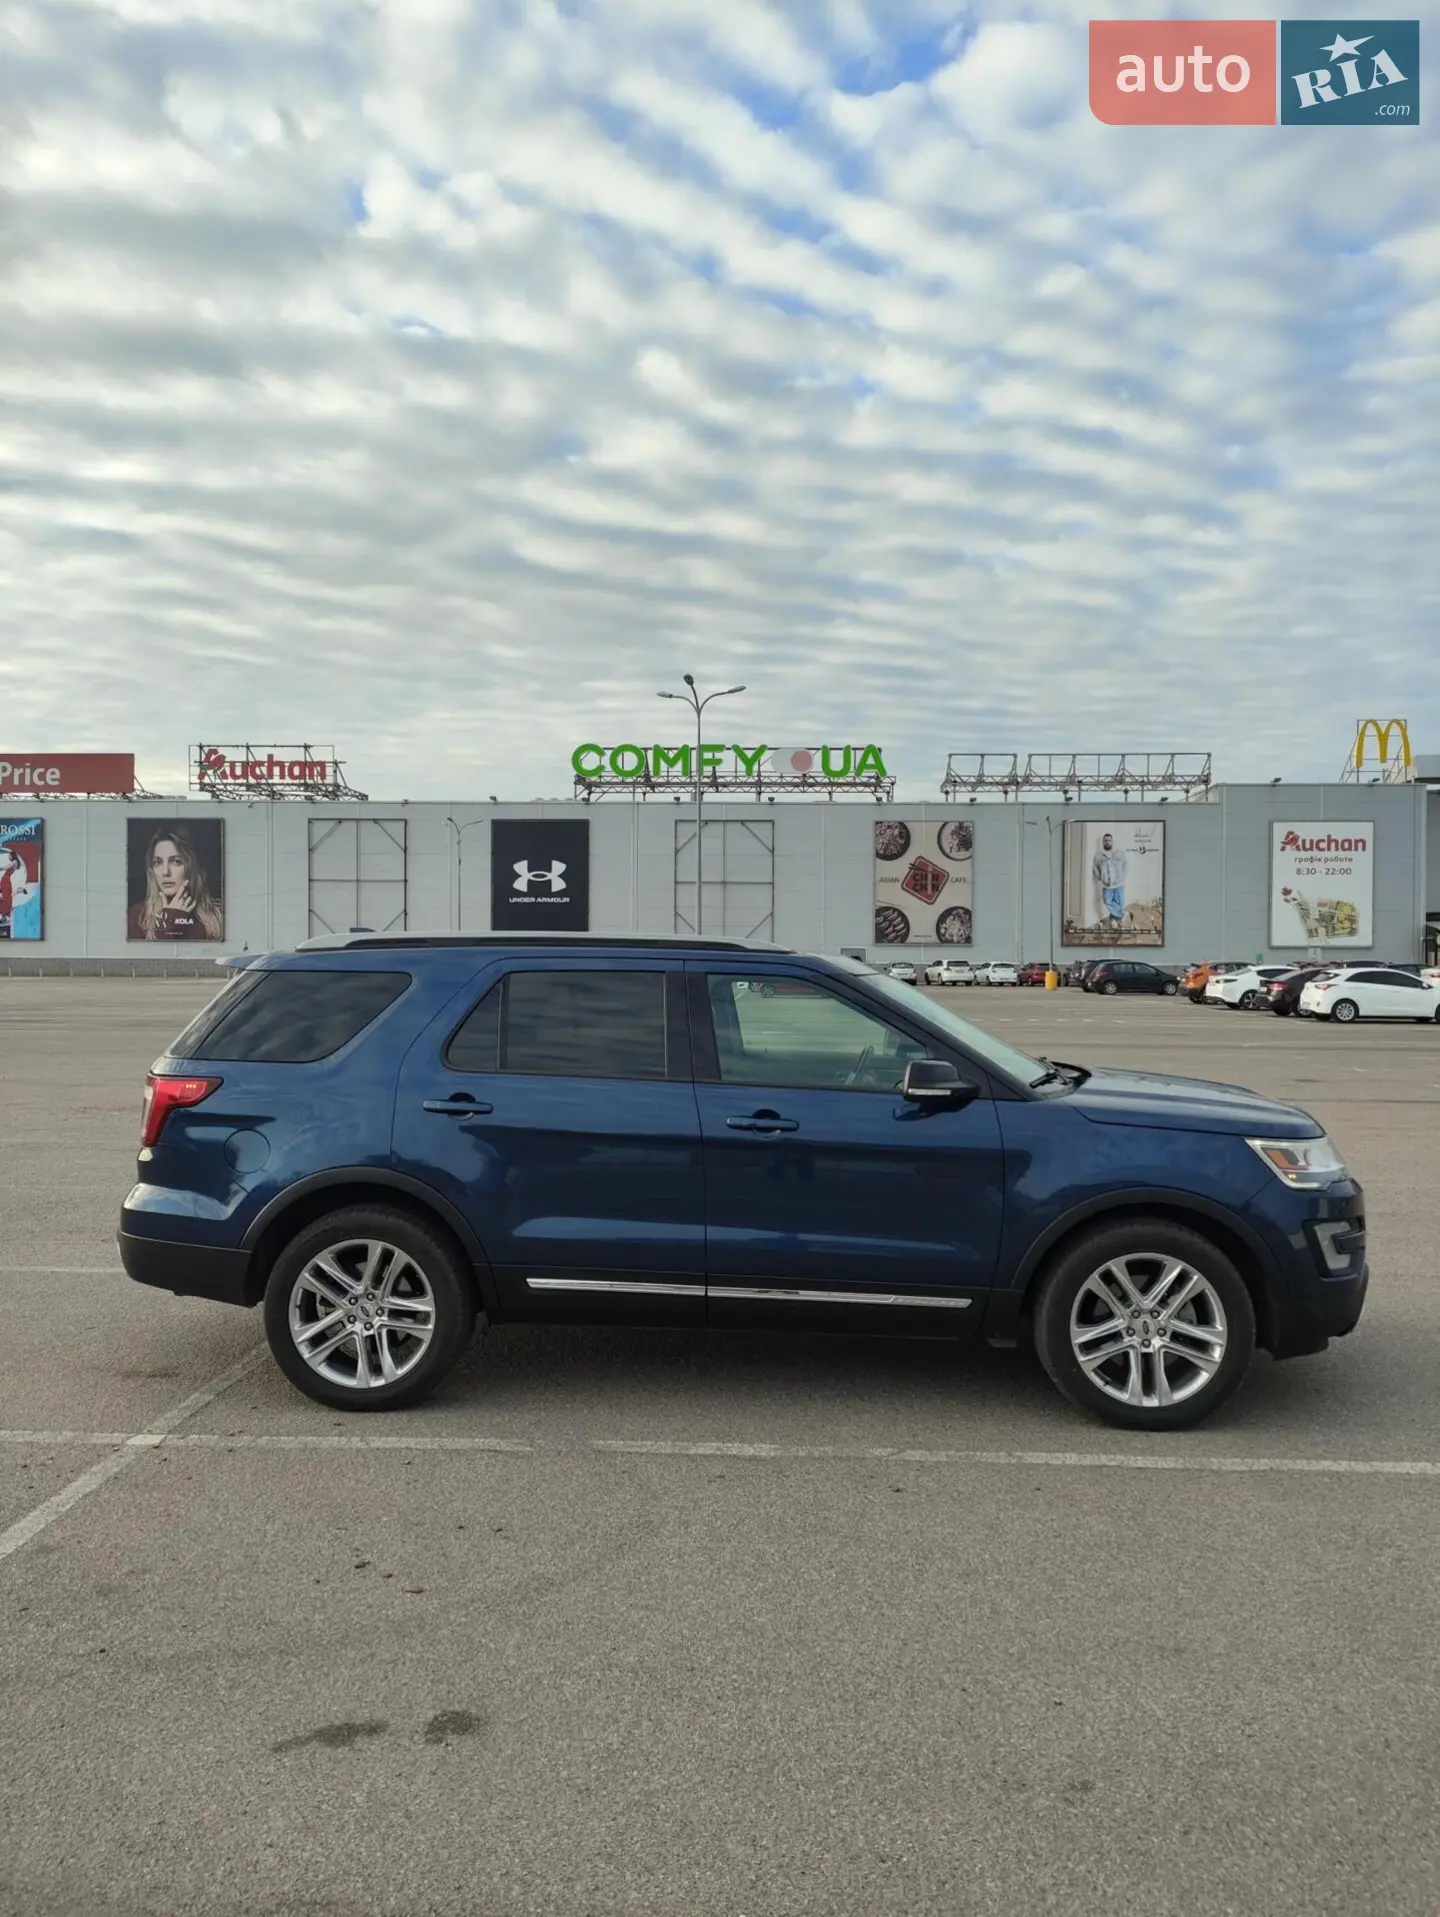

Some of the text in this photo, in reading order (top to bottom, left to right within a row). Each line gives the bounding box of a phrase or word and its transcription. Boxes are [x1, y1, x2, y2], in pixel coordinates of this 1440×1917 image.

[198, 748, 327, 781] Auchan
[571, 743, 889, 778] COMFY UA
[0, 762, 61, 786] Price
[1280, 830, 1367, 852] Auchan
[1295, 867, 1317, 876] 8:30
[1324, 867, 1352, 876] 22:00
